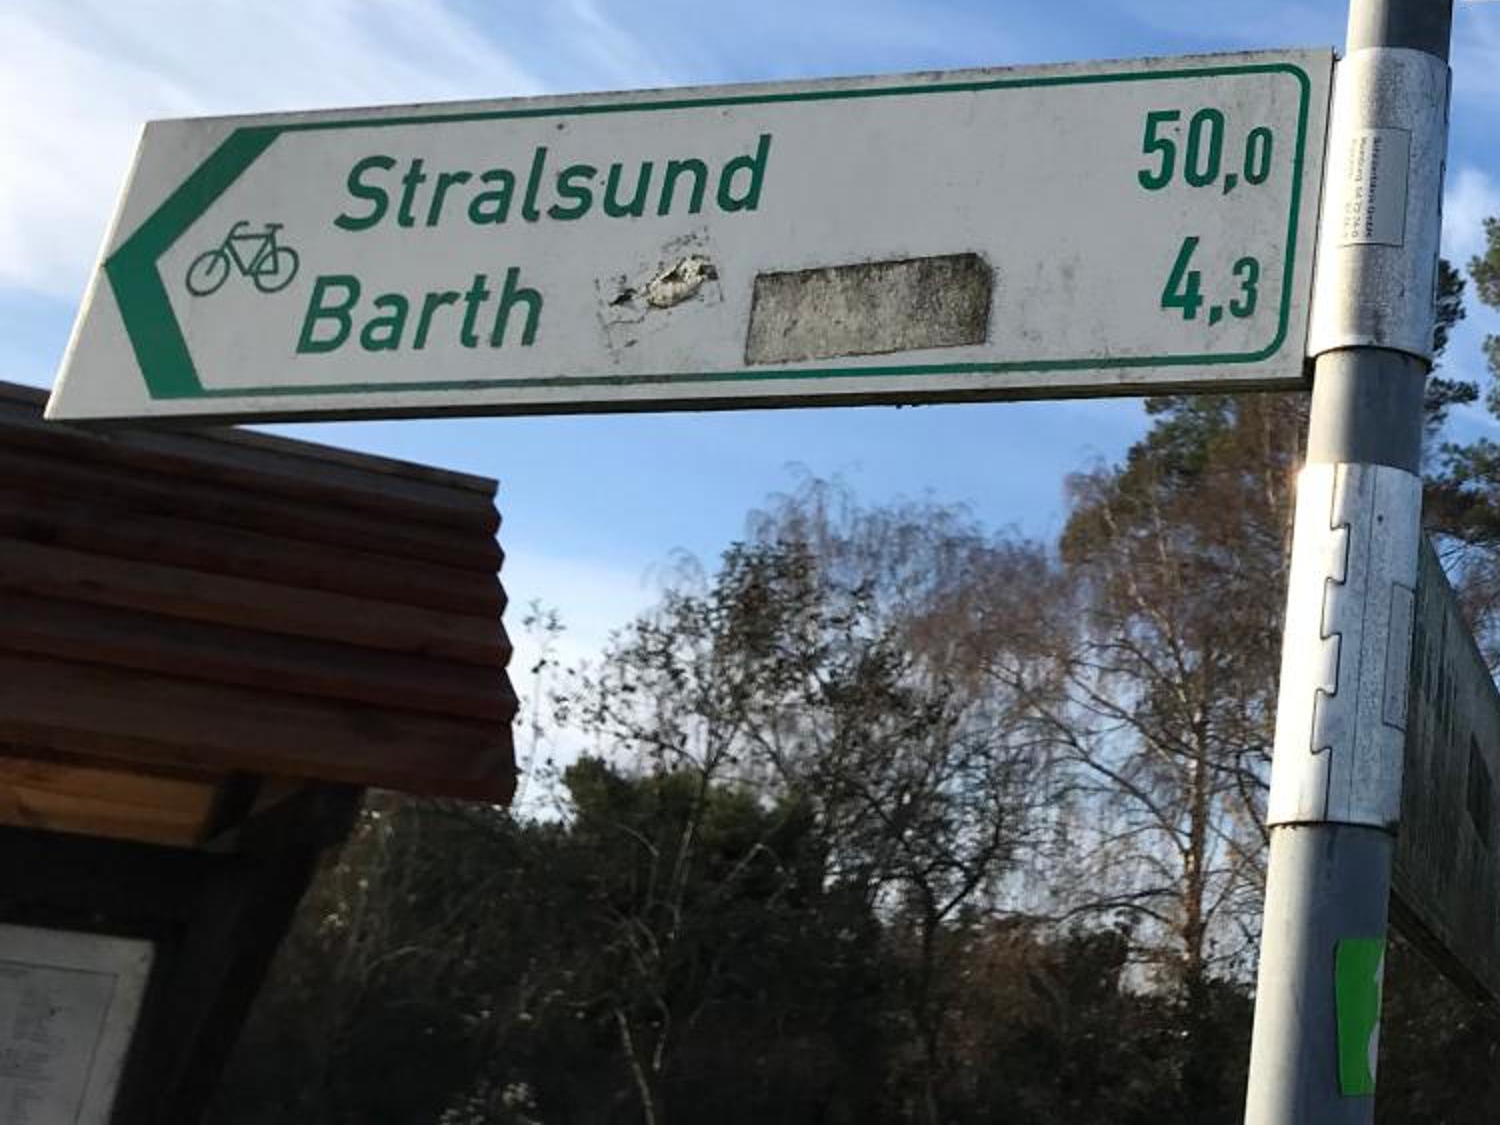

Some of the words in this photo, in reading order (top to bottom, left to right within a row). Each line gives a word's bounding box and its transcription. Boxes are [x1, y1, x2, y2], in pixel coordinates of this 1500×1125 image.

[333, 133, 773, 232] Stralsund
[1136, 106, 1274, 195] 50,0
[295, 266, 545, 355] Barth
[1159, 235, 1261, 326] 4,3
